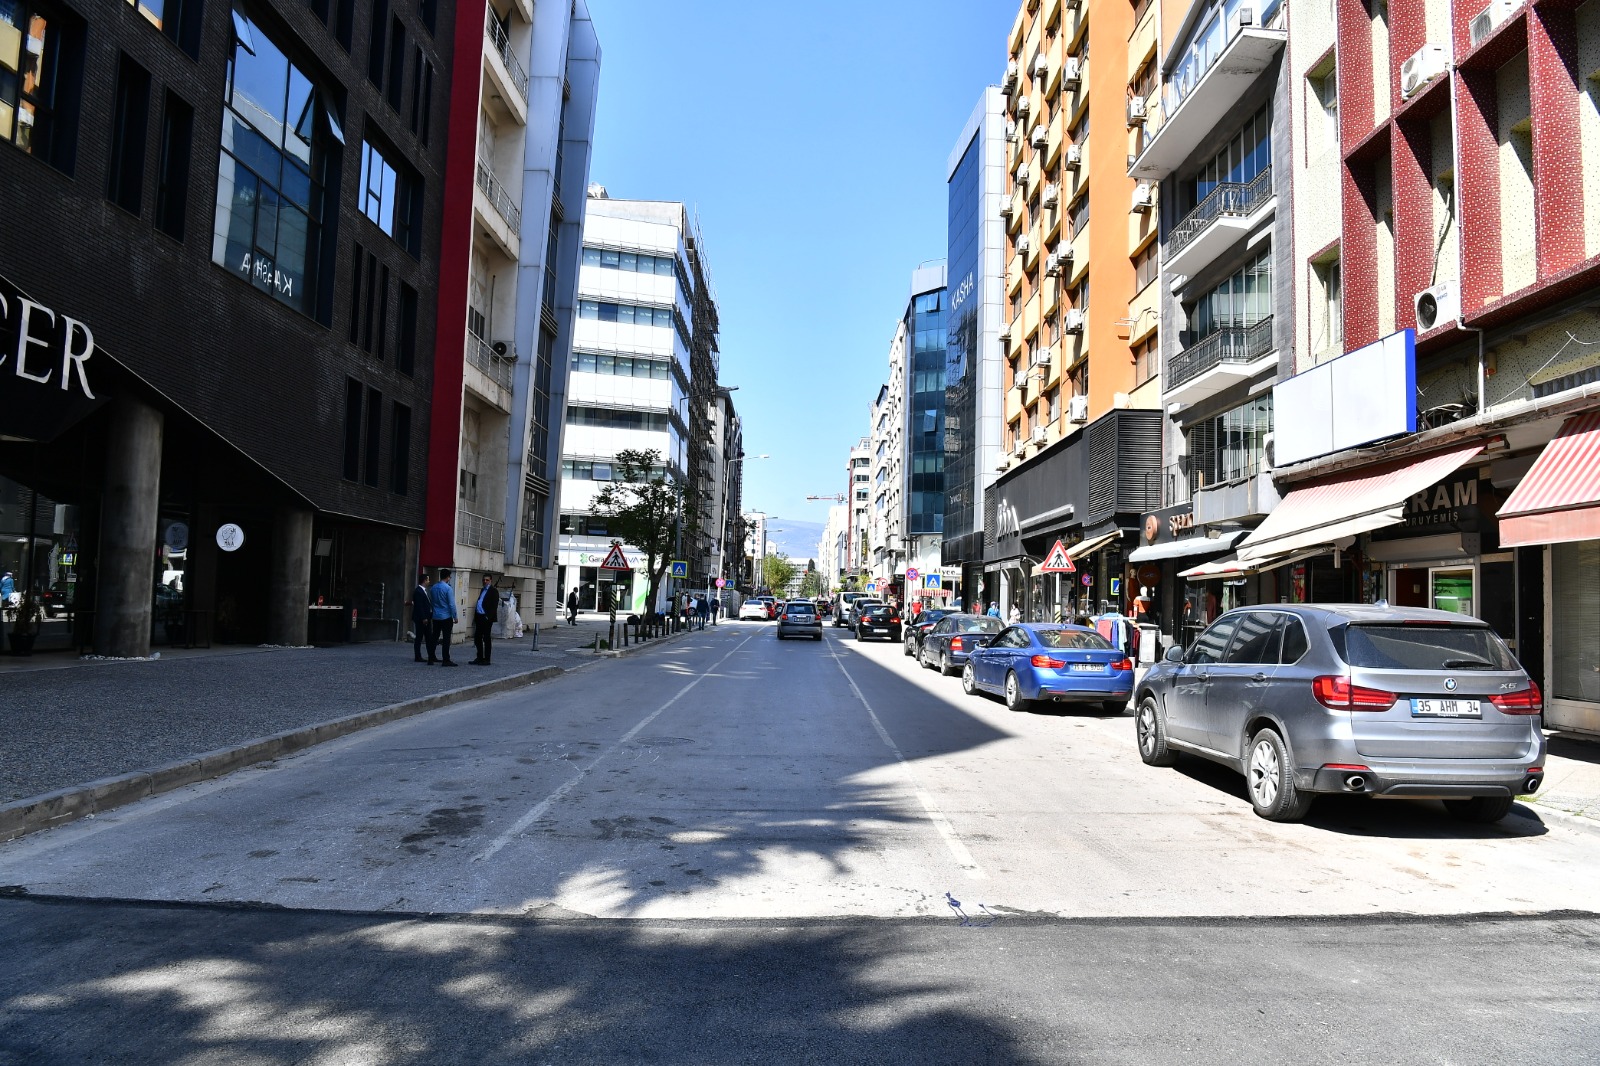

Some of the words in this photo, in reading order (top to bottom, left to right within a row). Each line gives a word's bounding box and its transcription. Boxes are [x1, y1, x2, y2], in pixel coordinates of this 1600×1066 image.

[951, 271, 974, 314] KASHA
[0, 291, 96, 399] ER
[1402, 479, 1478, 515] RAM
[1500, 682, 1518, 690] X5
[1418, 700, 1431, 712] 35
[1440, 700, 1458, 713] AHM
[1467, 701, 1479, 713] 34
